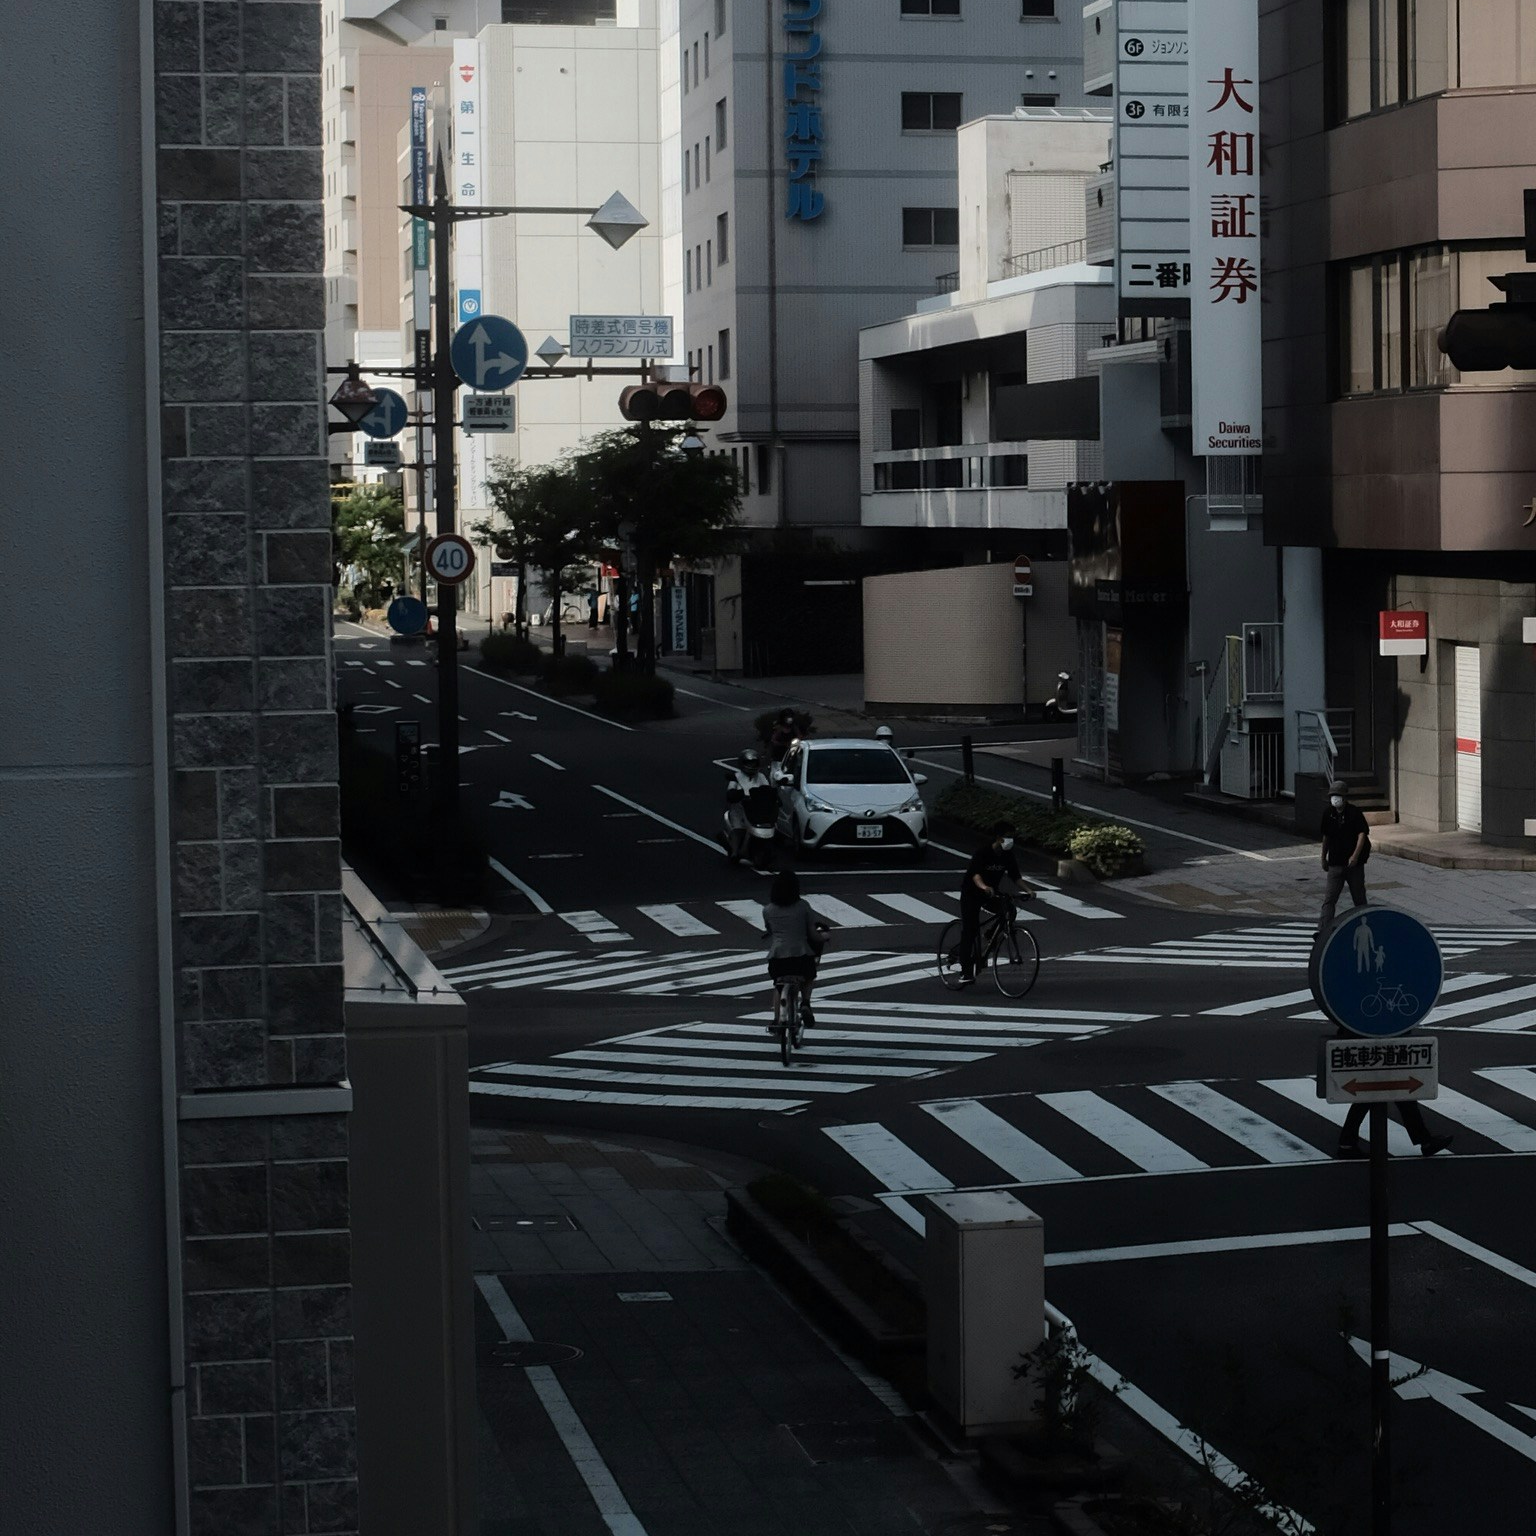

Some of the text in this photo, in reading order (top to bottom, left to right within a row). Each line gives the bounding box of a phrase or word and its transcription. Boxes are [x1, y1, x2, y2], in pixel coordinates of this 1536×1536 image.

[1126, 41, 1143, 55] 6F
[1127, 103, 1143, 117] 3F
[460, 101, 475, 196] 第一生命
[1206, 68, 1257, 304] 大和証券
[575, 319, 668, 335] 時差式信号機
[577, 339, 667, 354] スクランブル式
[1219, 422, 1250, 434] Daiwa
[1208, 436, 1261, 449] Securities
[436, 548, 463, 570] 40
[1390, 619, 1419, 628] 大和証券
[1331, 1044, 1433, 1069] 自転車歩道通行可
